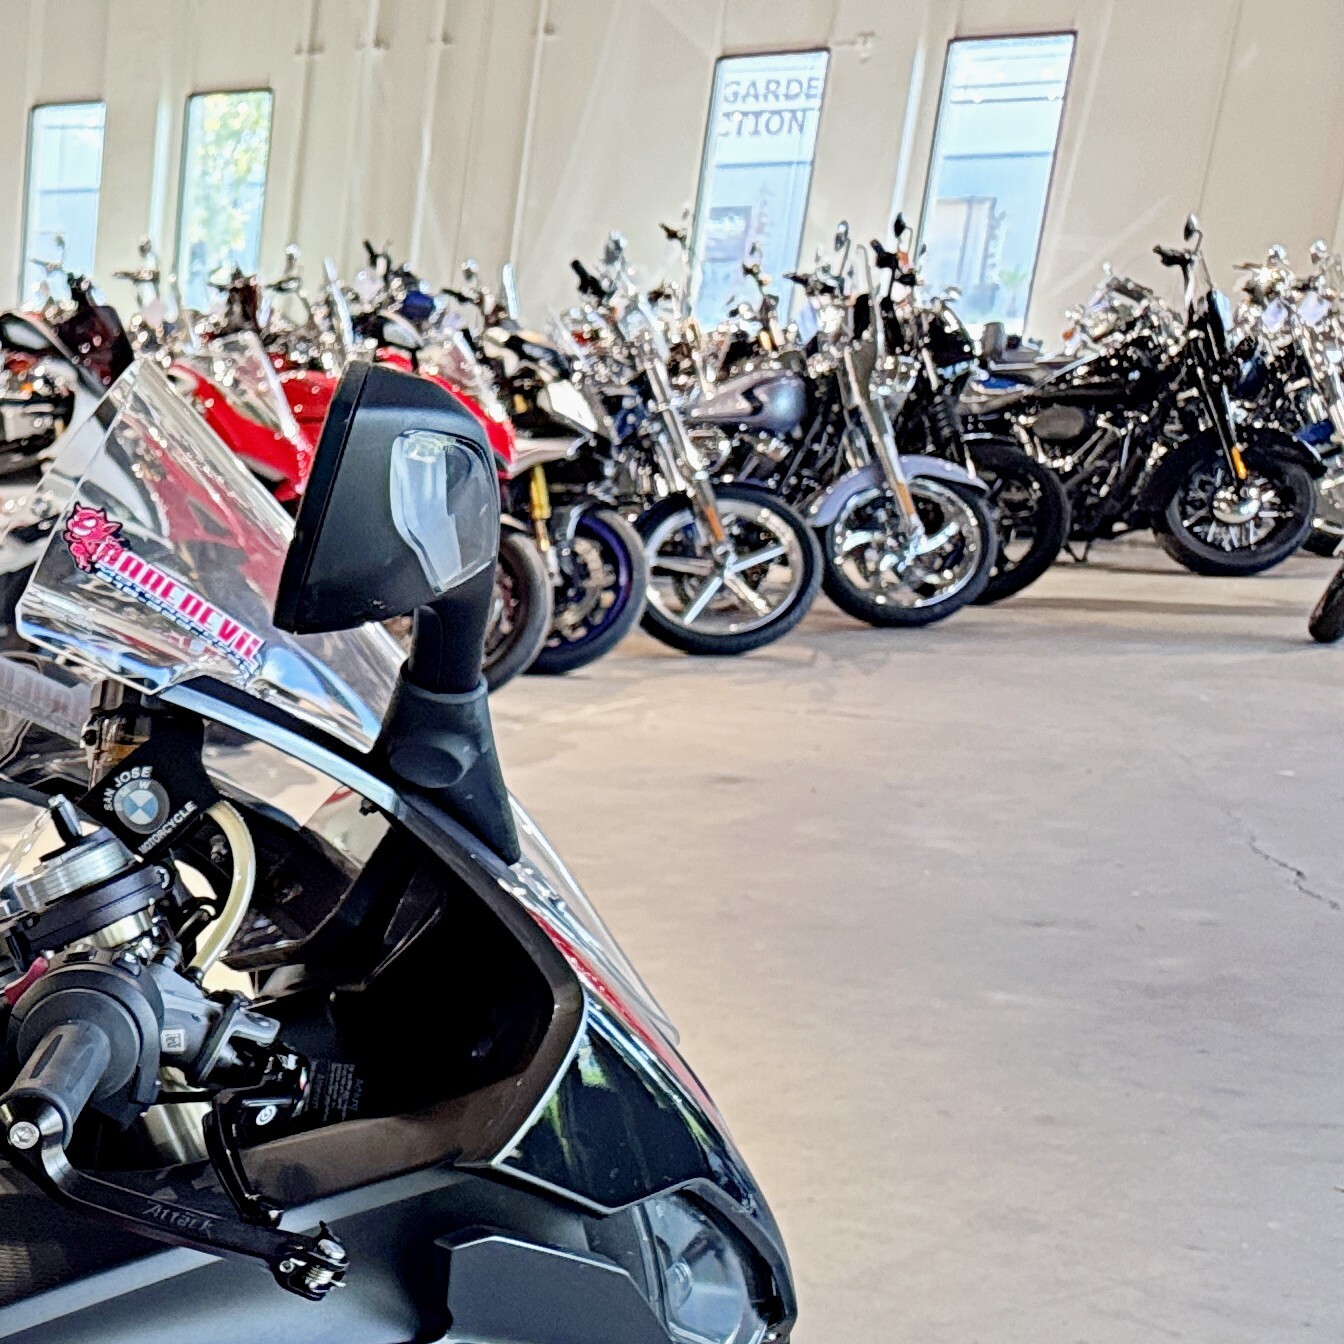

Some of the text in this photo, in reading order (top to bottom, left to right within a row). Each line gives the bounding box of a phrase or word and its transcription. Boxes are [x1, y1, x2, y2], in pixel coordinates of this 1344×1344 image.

[723, 77, 819, 104] GARDE
[114, 765, 153, 788] JOSE
[138, 800, 198, 854] MOTORCYCLE
